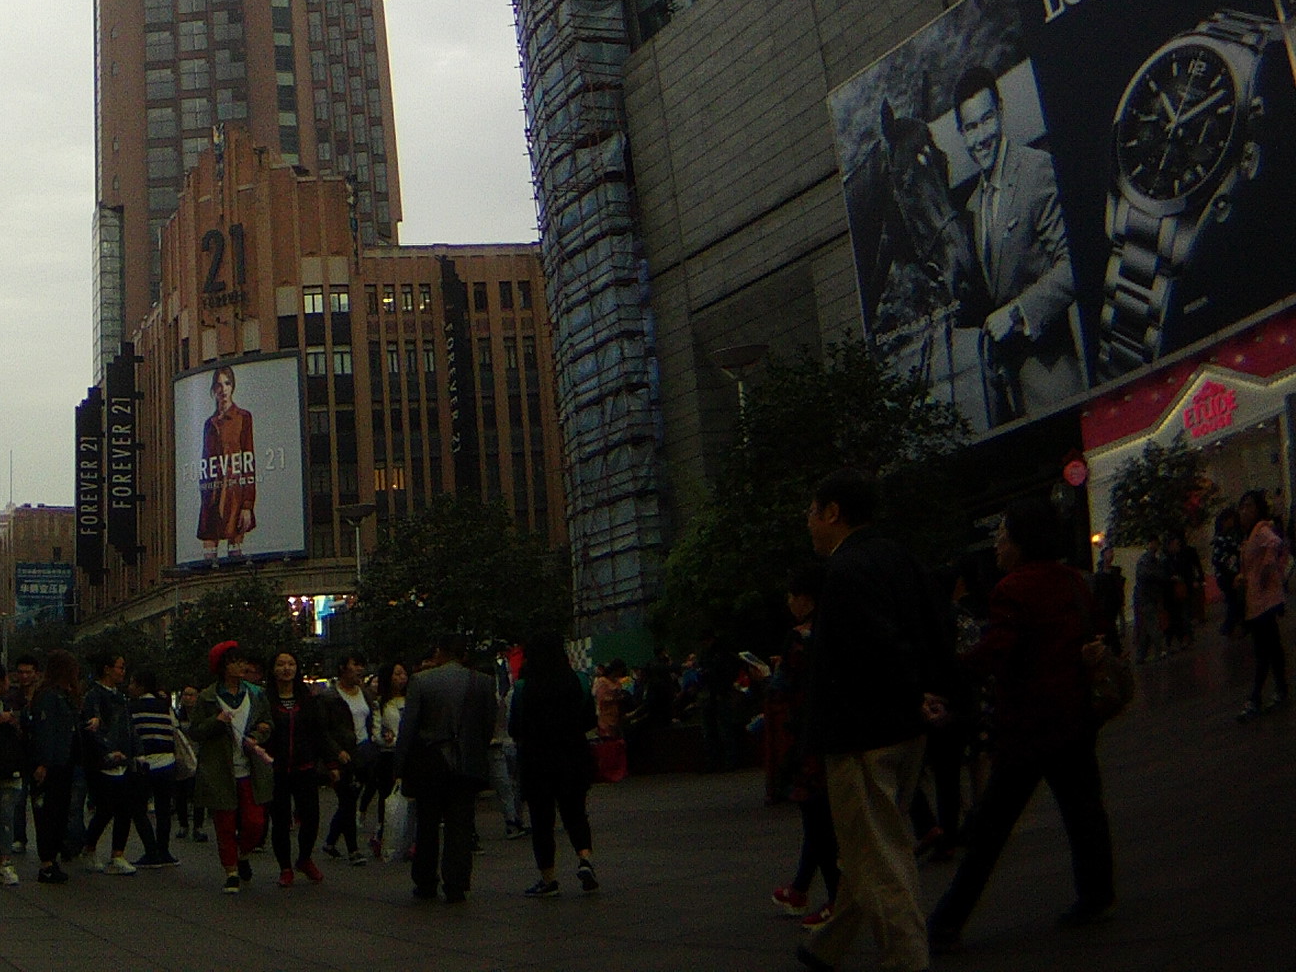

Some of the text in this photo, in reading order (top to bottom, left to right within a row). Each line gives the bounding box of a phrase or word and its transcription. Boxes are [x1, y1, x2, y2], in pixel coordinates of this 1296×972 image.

[202, 222, 246, 293] 21
[1183, 389, 1239, 429] ETUDE
[80, 435, 99, 536] FOREVER 21
[112, 396, 133, 509] FOREVER 21
[265, 447, 285, 472] 21
